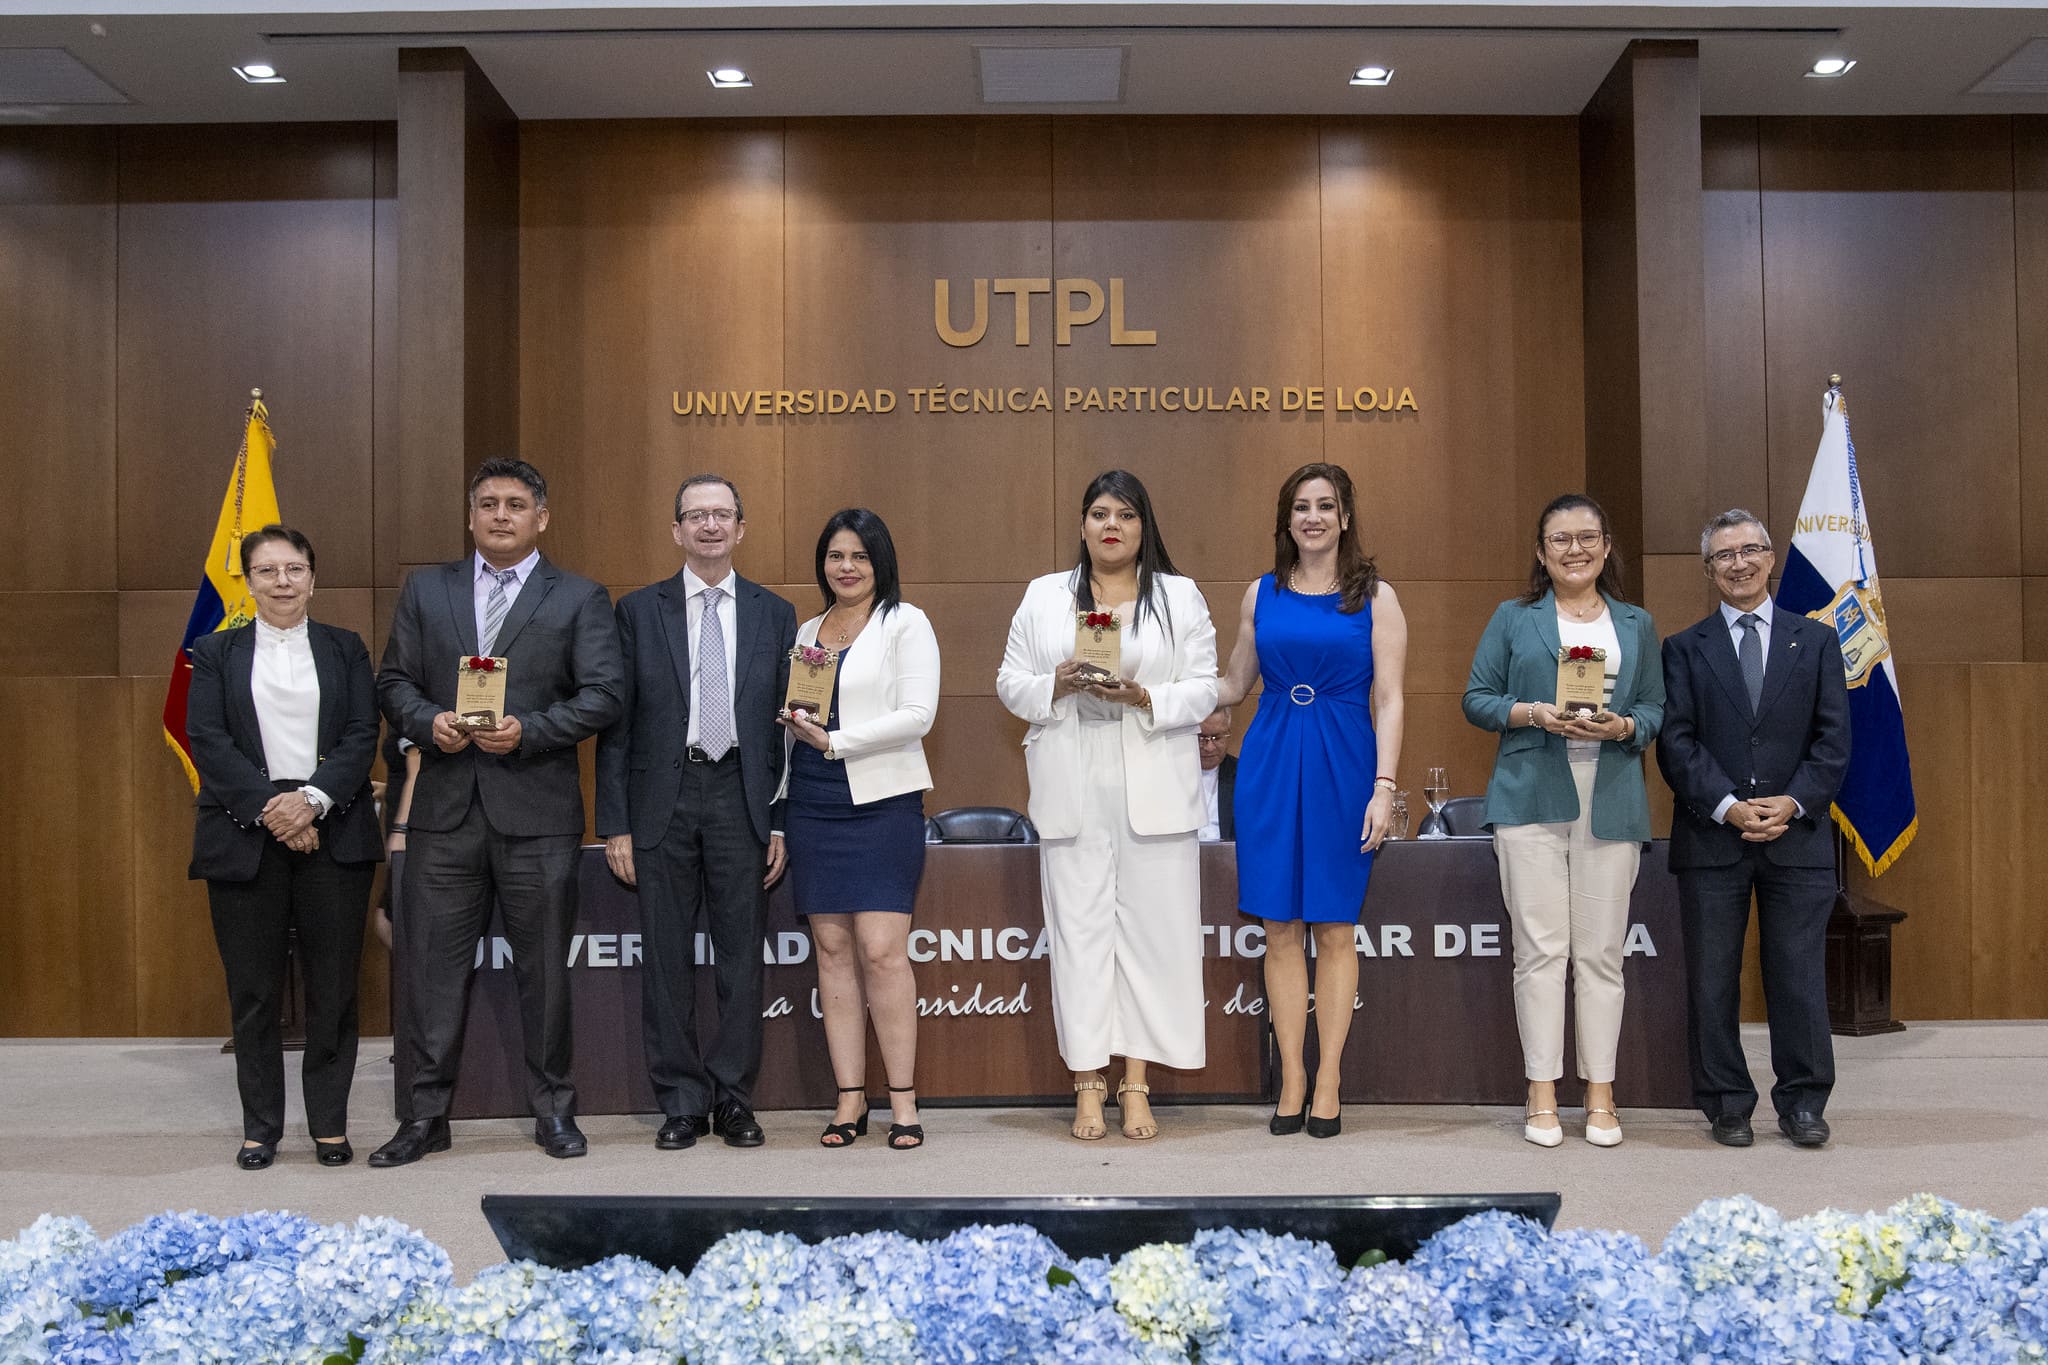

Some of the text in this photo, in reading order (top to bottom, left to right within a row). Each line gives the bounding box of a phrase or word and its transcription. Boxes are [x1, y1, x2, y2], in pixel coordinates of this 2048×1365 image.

[934, 277, 1158, 347] UTPL
[672, 382, 1419, 416] UNIVERSIDAD TÉCNICA PARTICULAR DE LOJA
[907, 927, 1051, 963] CNICA
[1433, 923, 1501, 958] DE
[1223, 982, 1264, 1016] de
